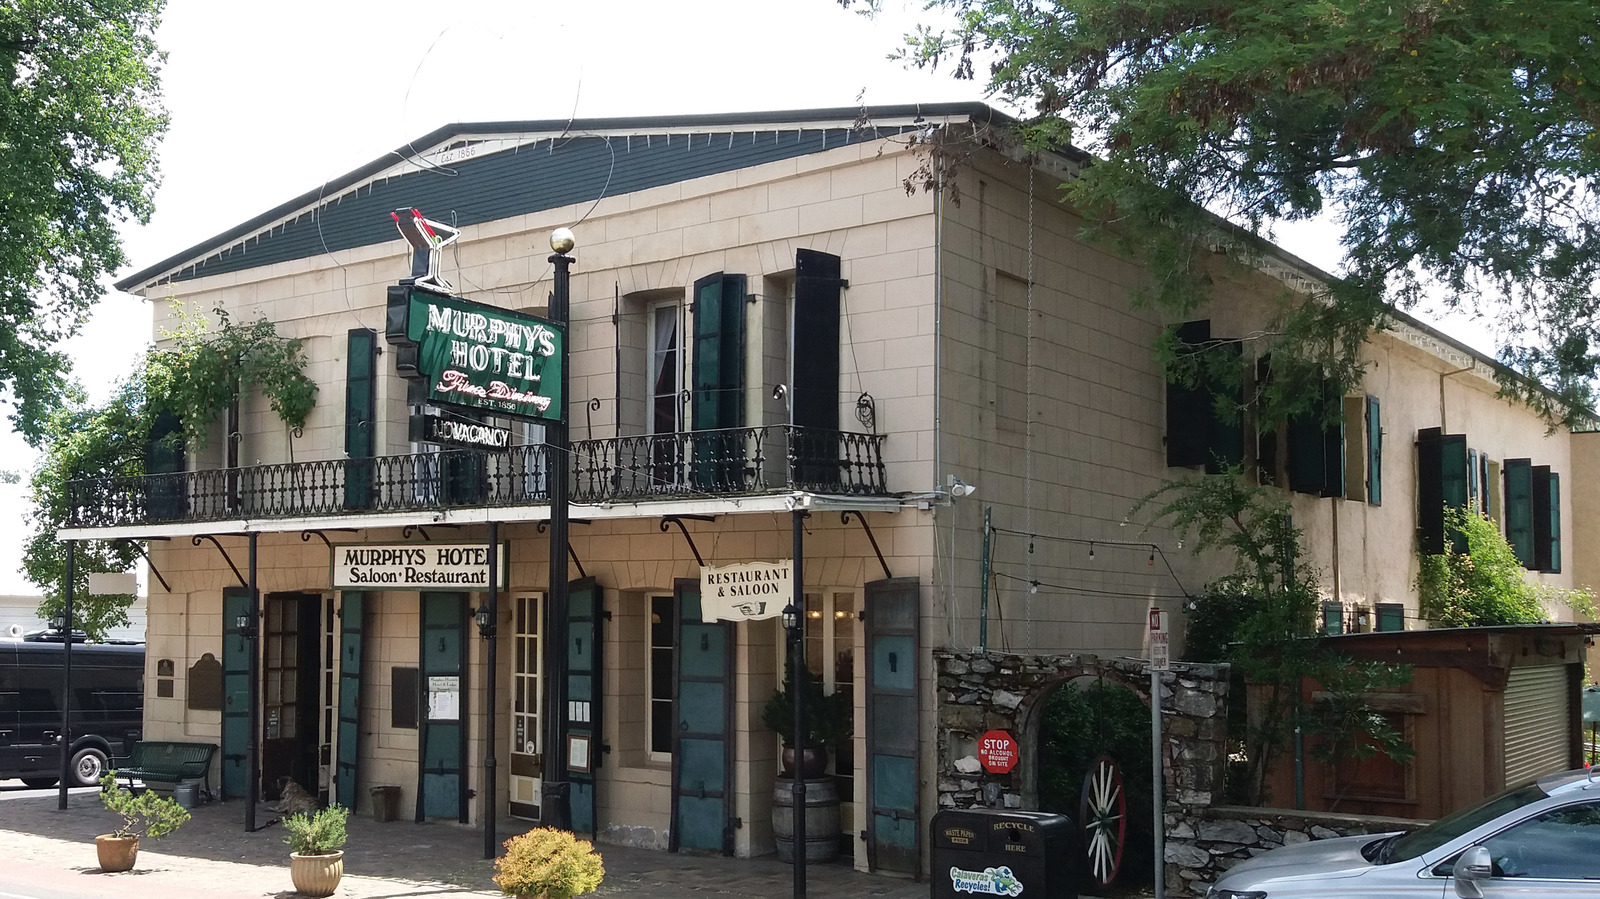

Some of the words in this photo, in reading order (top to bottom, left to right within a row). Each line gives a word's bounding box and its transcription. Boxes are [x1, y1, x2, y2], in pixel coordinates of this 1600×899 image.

[458, 147, 475, 159] 1856
[450, 340, 540, 381] HOTEL
[436, 370, 487, 397] Fine
[488, 380, 551, 411] Dining
[478, 398, 497, 407] EST.
[498, 402, 516, 410] 1856
[433, 419, 453, 439] NO
[452, 421, 508, 447] VACANCY
[344, 549, 426, 565] MURPHYS
[349, 567, 398, 583] Saloon
[404, 567, 486, 583] Restaurant
[708, 568, 789, 584] RESTAURANT
[717, 586, 725, 597] &
[730, 583, 779, 596] SALOON
[984, 739, 1010, 750] STOP
[945, 829, 960, 837] WASTE
[993, 822, 1035, 833] RECYCLE
[1005, 844, 1026, 852] HERE
[951, 868, 989, 881] Calaveras
[955, 879, 991, 892] Recycles!
